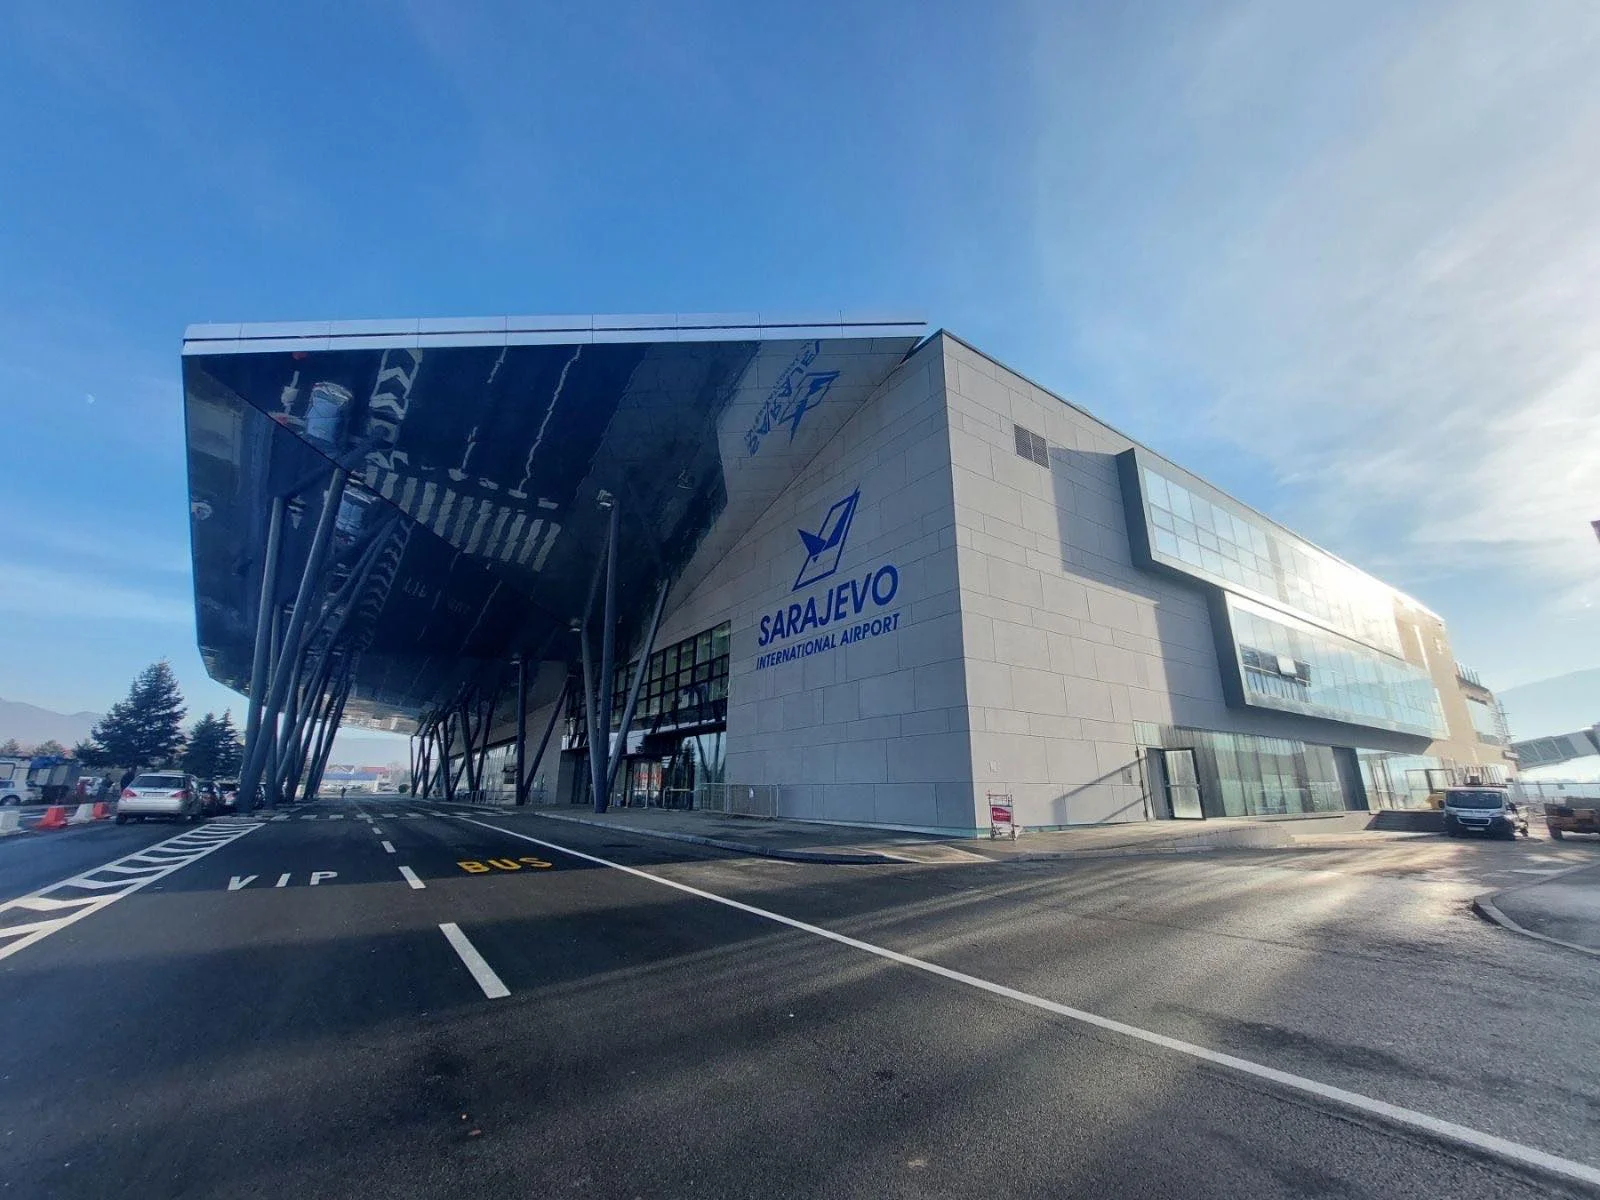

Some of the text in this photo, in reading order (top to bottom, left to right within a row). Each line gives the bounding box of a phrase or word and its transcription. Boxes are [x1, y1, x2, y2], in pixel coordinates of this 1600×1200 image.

[758, 564, 899, 647] SARAJEVO
[756, 613, 900, 671] INTERNATIONAL AIRPORT
[227, 871, 338, 891] VIP
[456, 857, 553, 873] BUS
